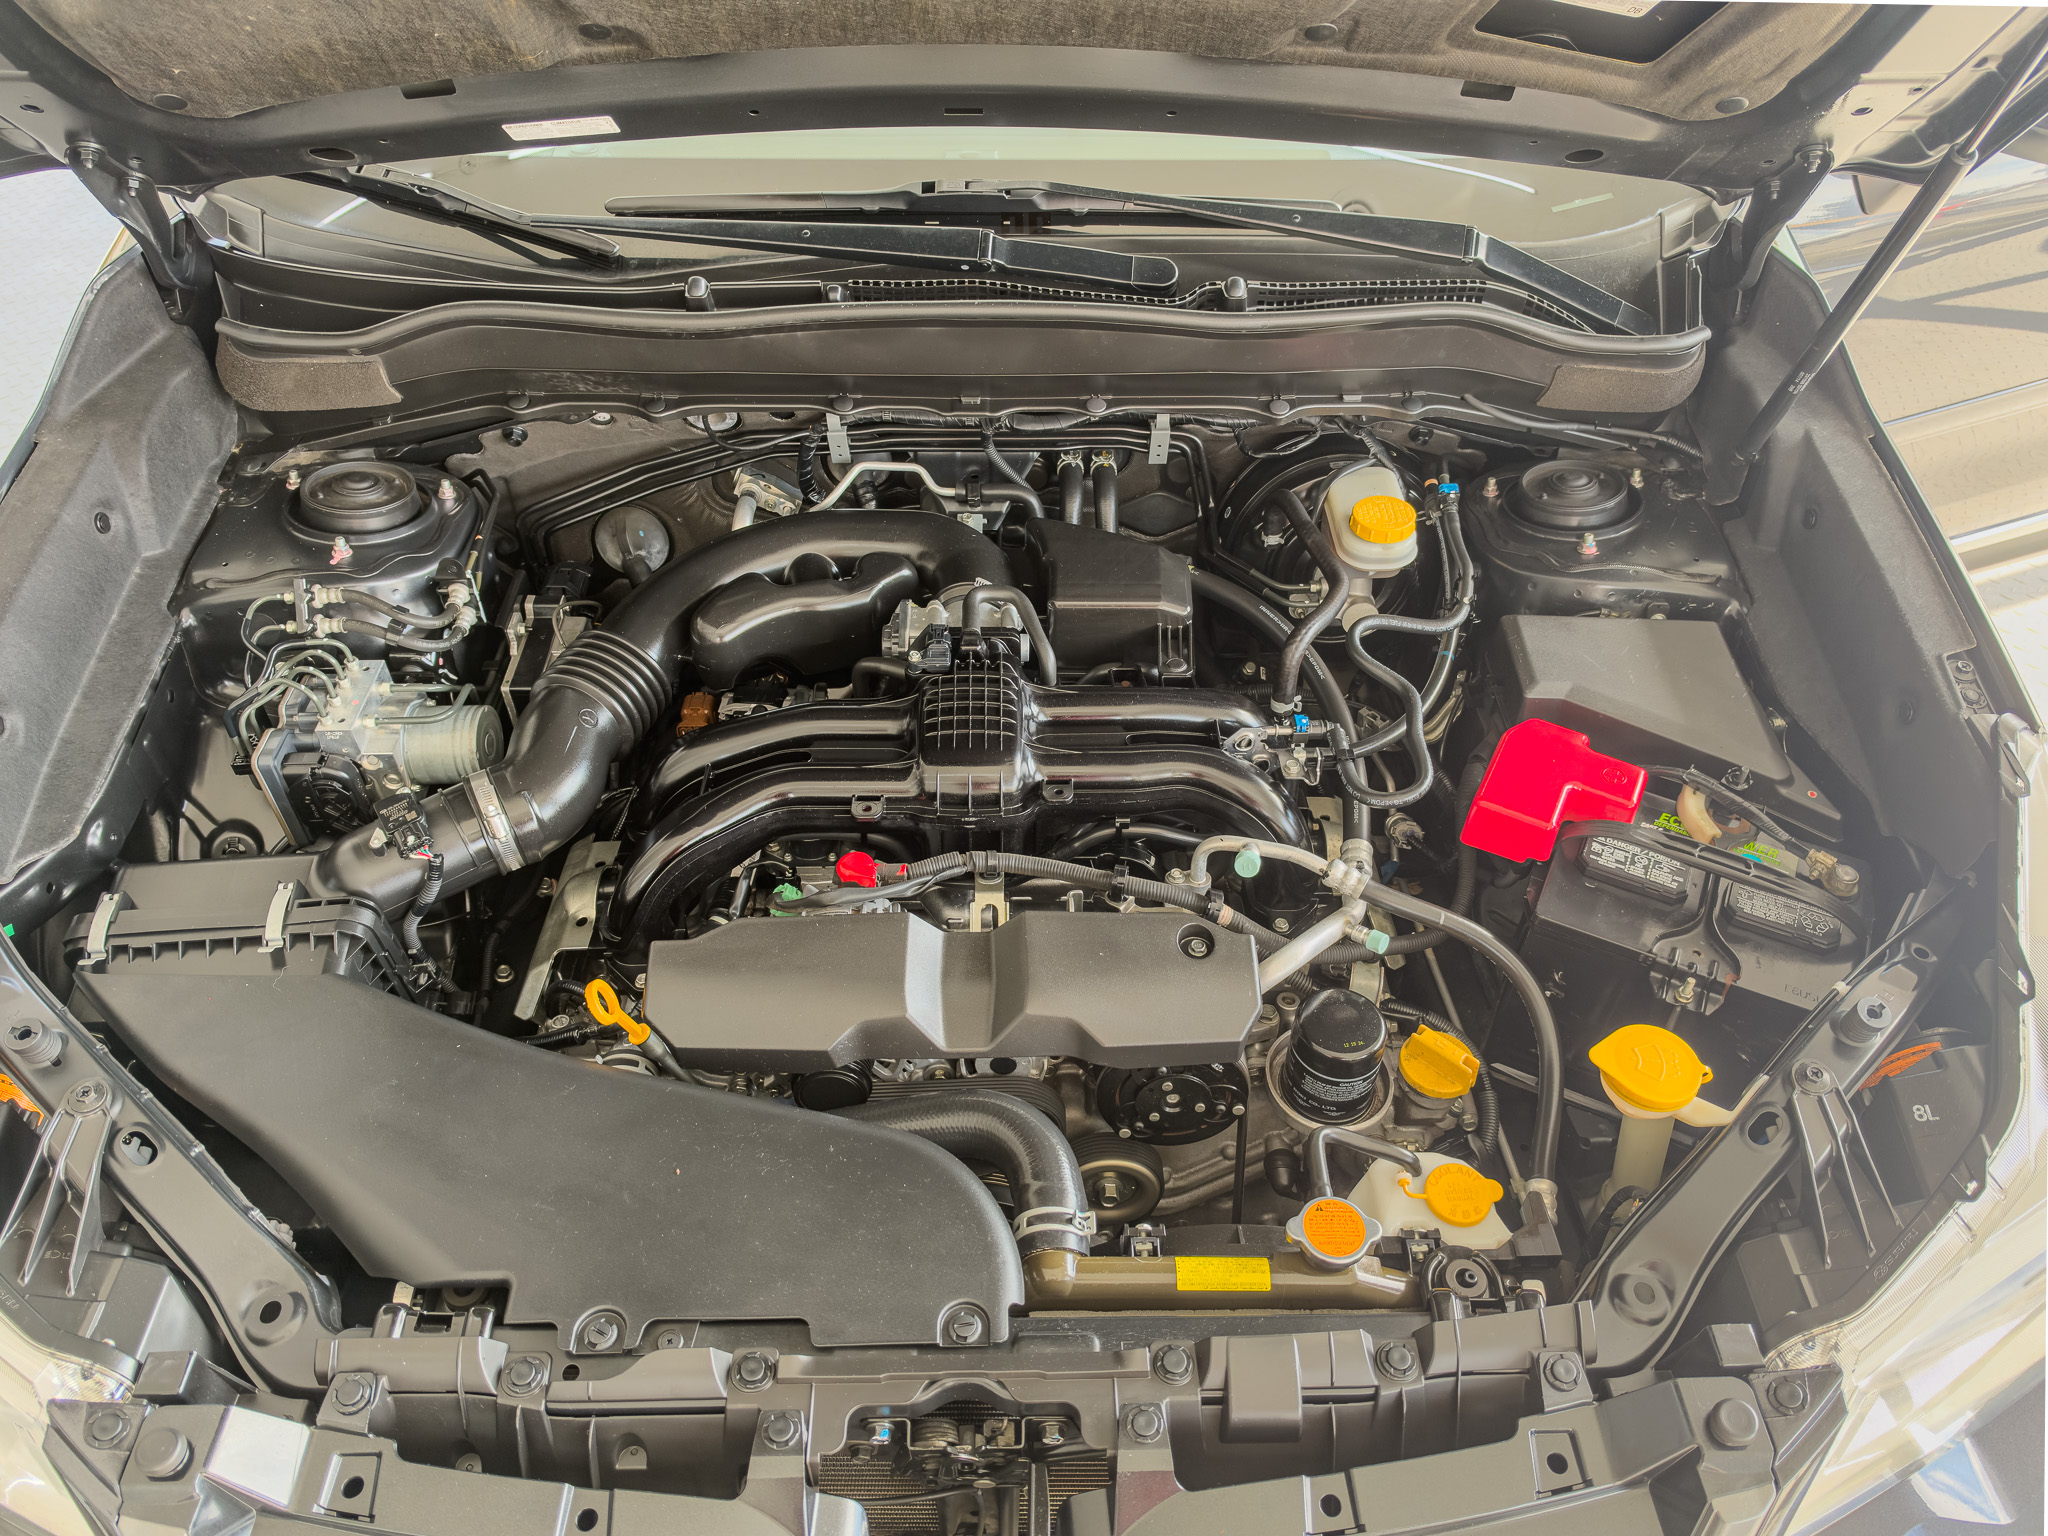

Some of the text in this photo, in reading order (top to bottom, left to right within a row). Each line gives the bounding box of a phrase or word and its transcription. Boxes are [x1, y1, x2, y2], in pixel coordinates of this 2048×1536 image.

[1606, 838, 1641, 853] DANGER
[1649, 851, 1681, 866] POISON
[1429, 1166, 1482, 1186] COOLANT
